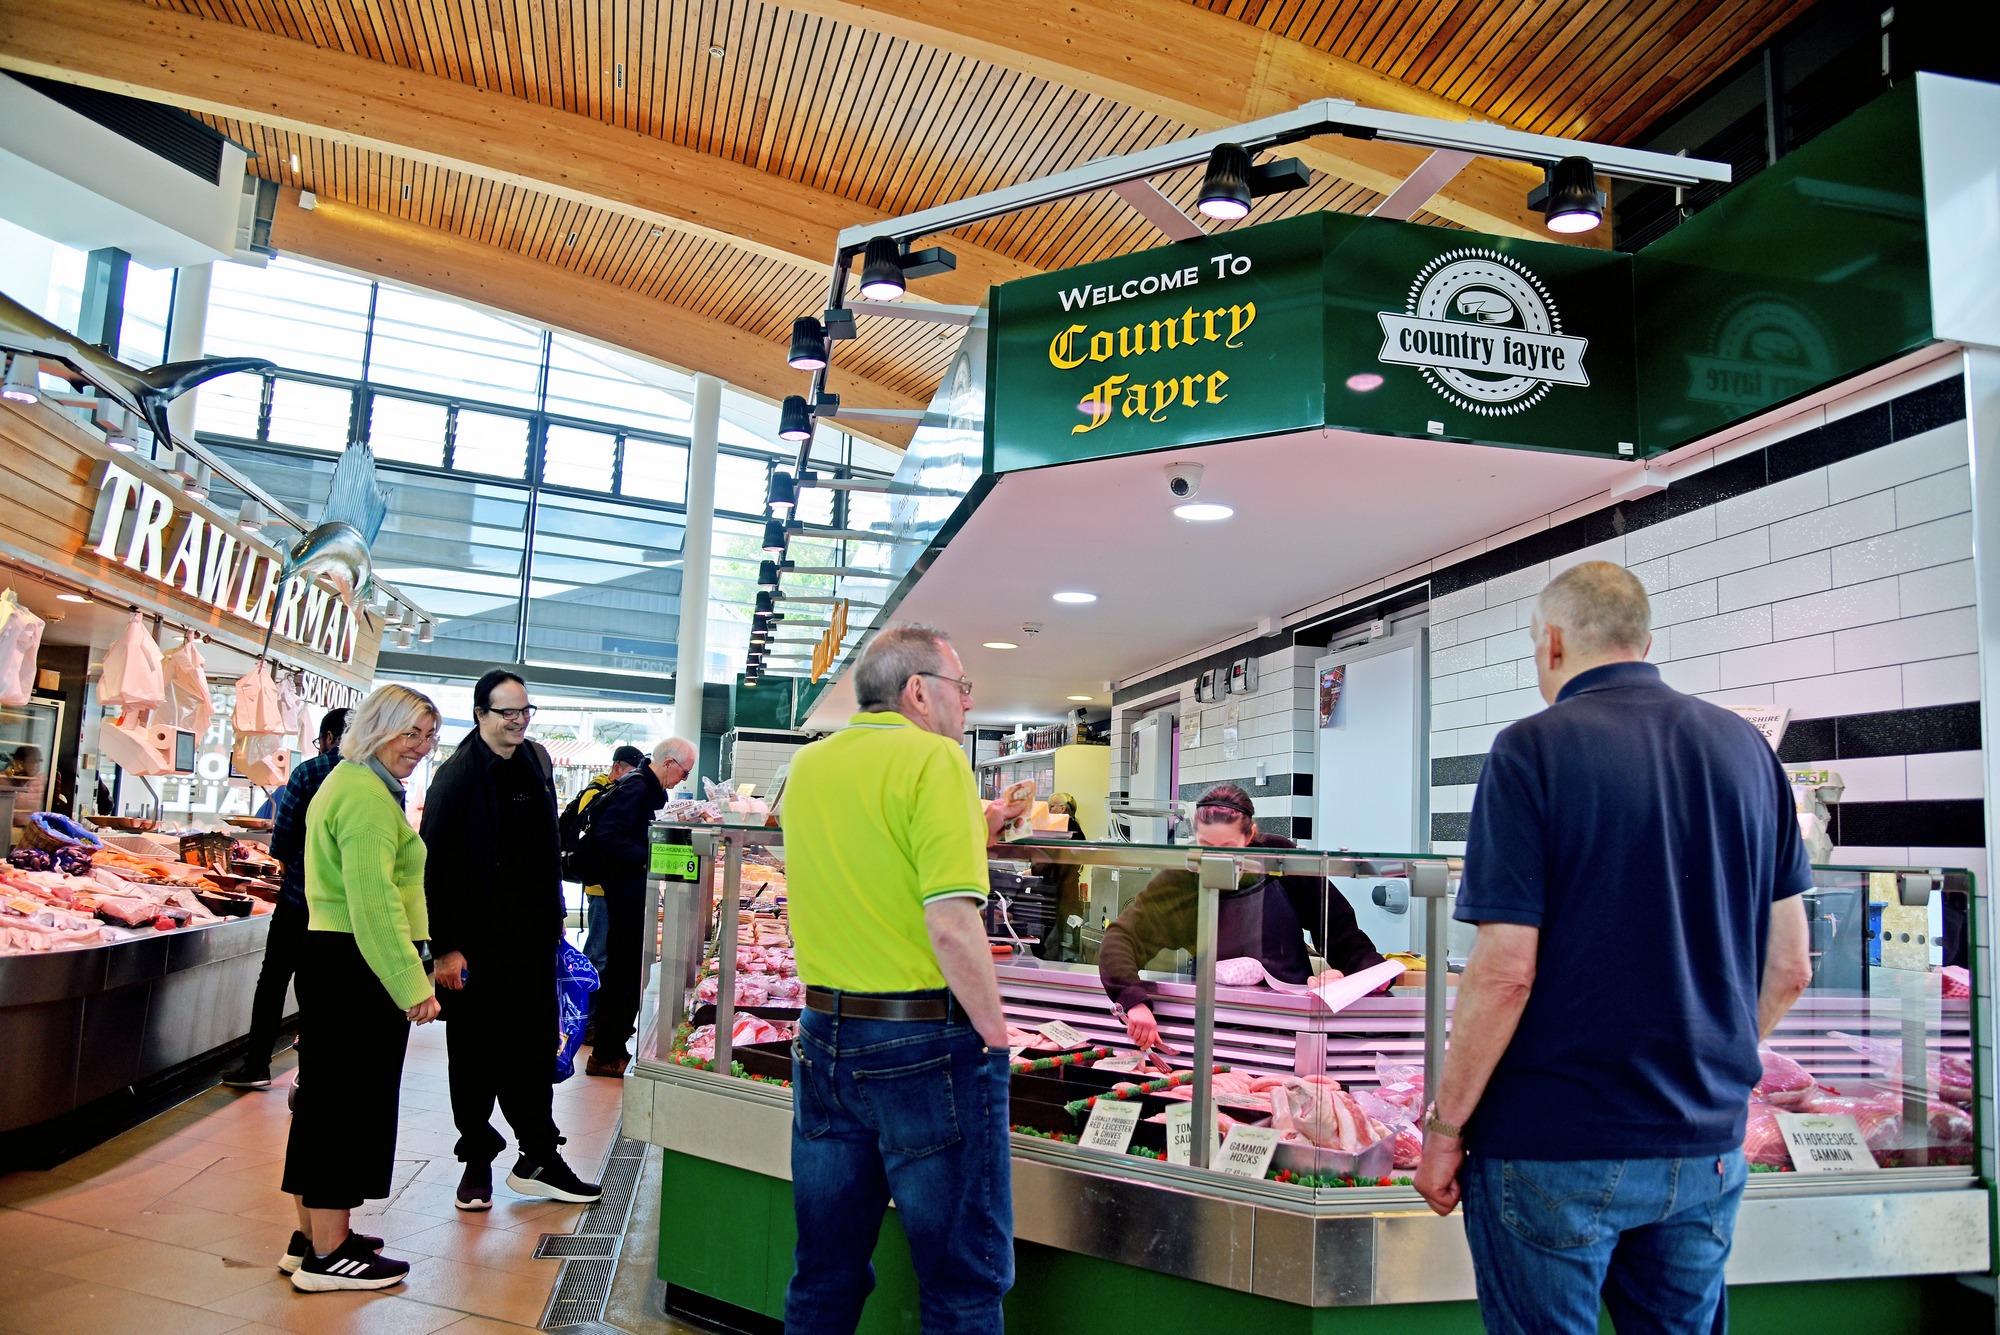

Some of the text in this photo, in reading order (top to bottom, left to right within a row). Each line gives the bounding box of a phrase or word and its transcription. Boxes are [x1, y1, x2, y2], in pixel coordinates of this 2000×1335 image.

[1048, 301, 1257, 370] Country
[1399, 327, 1566, 371] country fayre
[1071, 369, 1230, 436] Fayre
[94, 461, 361, 666] TRAWLERMAN
[300, 670, 349, 710] SEAFOOD
[1089, 1121, 1133, 1133] RED LEICESTER
[1092, 1115, 1135, 1125] LOCALLY PRODUCED
[1091, 1137, 1119, 1147] SAUSAGE
[1100, 1130, 1122, 1140] CHIVES
[1792, 1132, 1858, 1146] A1 HORSESHOE
[1229, 1141, 1268, 1156] GAMMON
[1810, 1148, 1853, 1162] GAMMON
[1229, 1152, 1259, 1165] HOCKS
